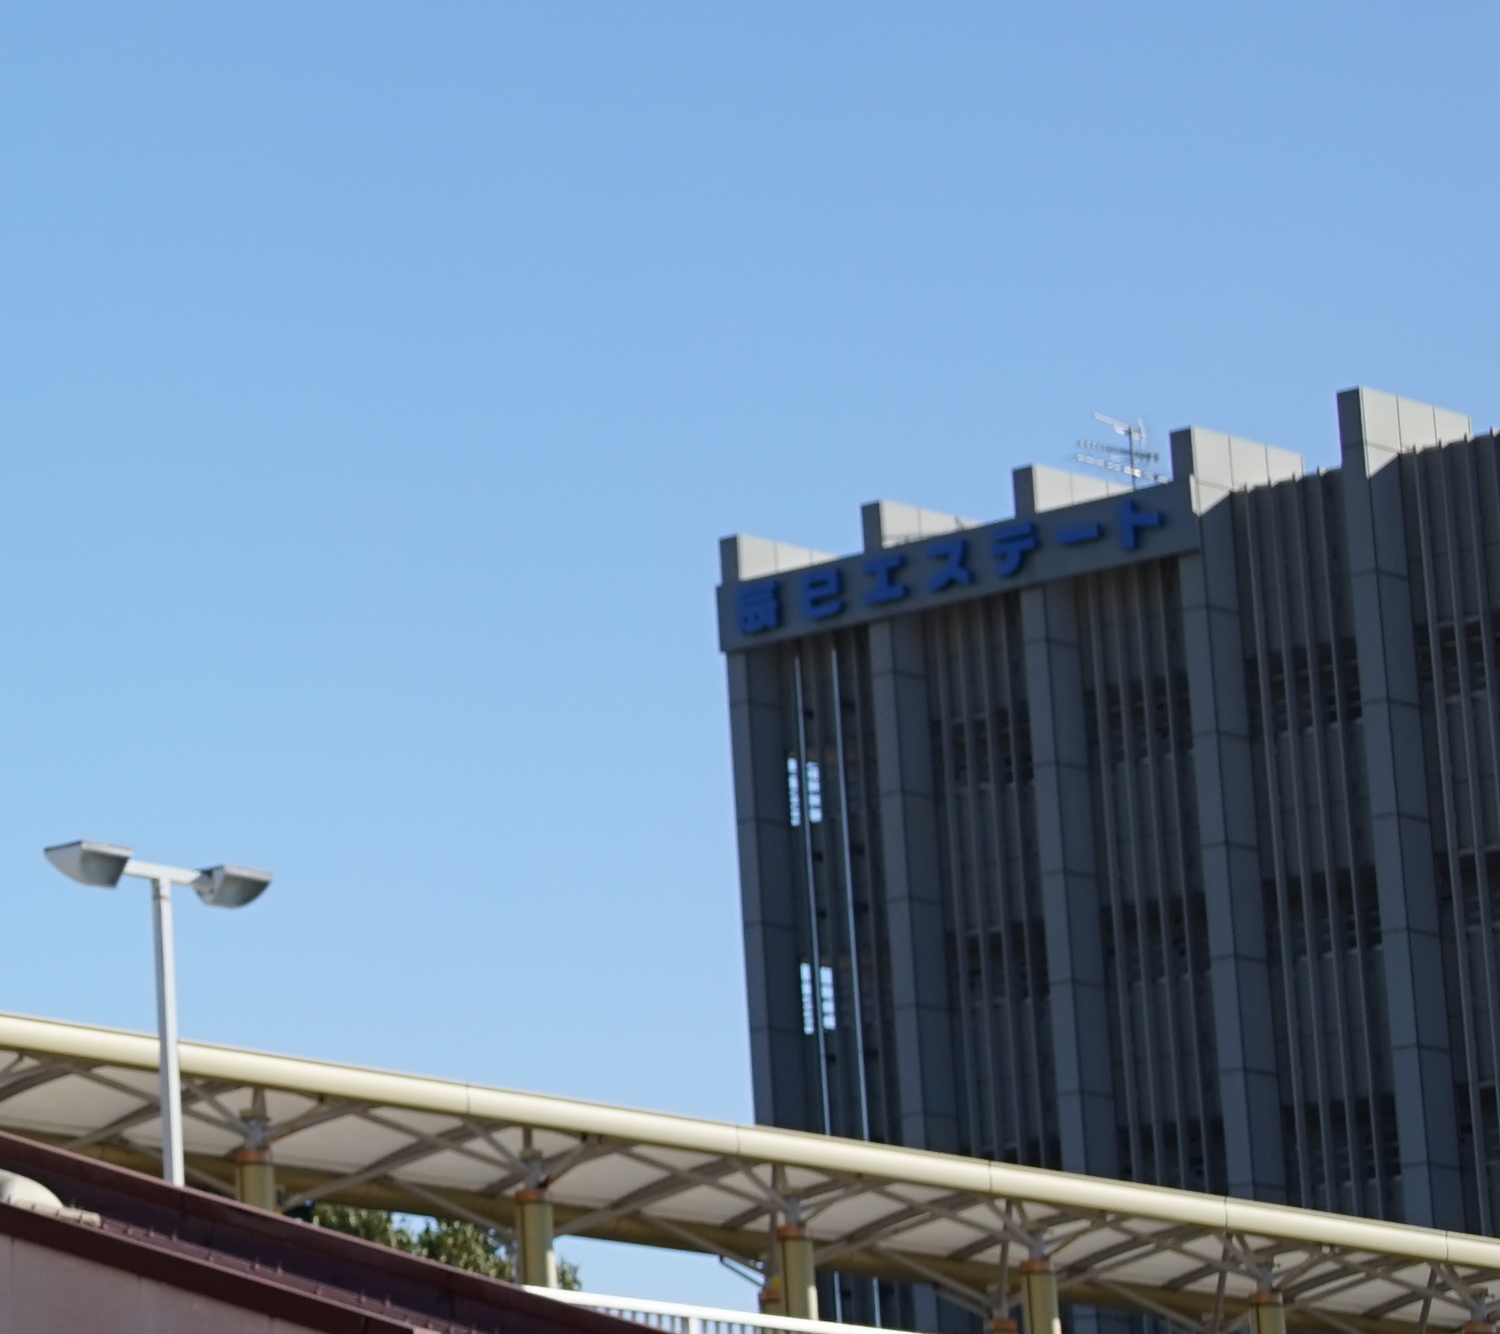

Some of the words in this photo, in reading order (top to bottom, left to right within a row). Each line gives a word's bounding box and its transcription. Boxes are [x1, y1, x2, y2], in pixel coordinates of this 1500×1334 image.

[736, 499, 1162, 634] 辰巳エステート
